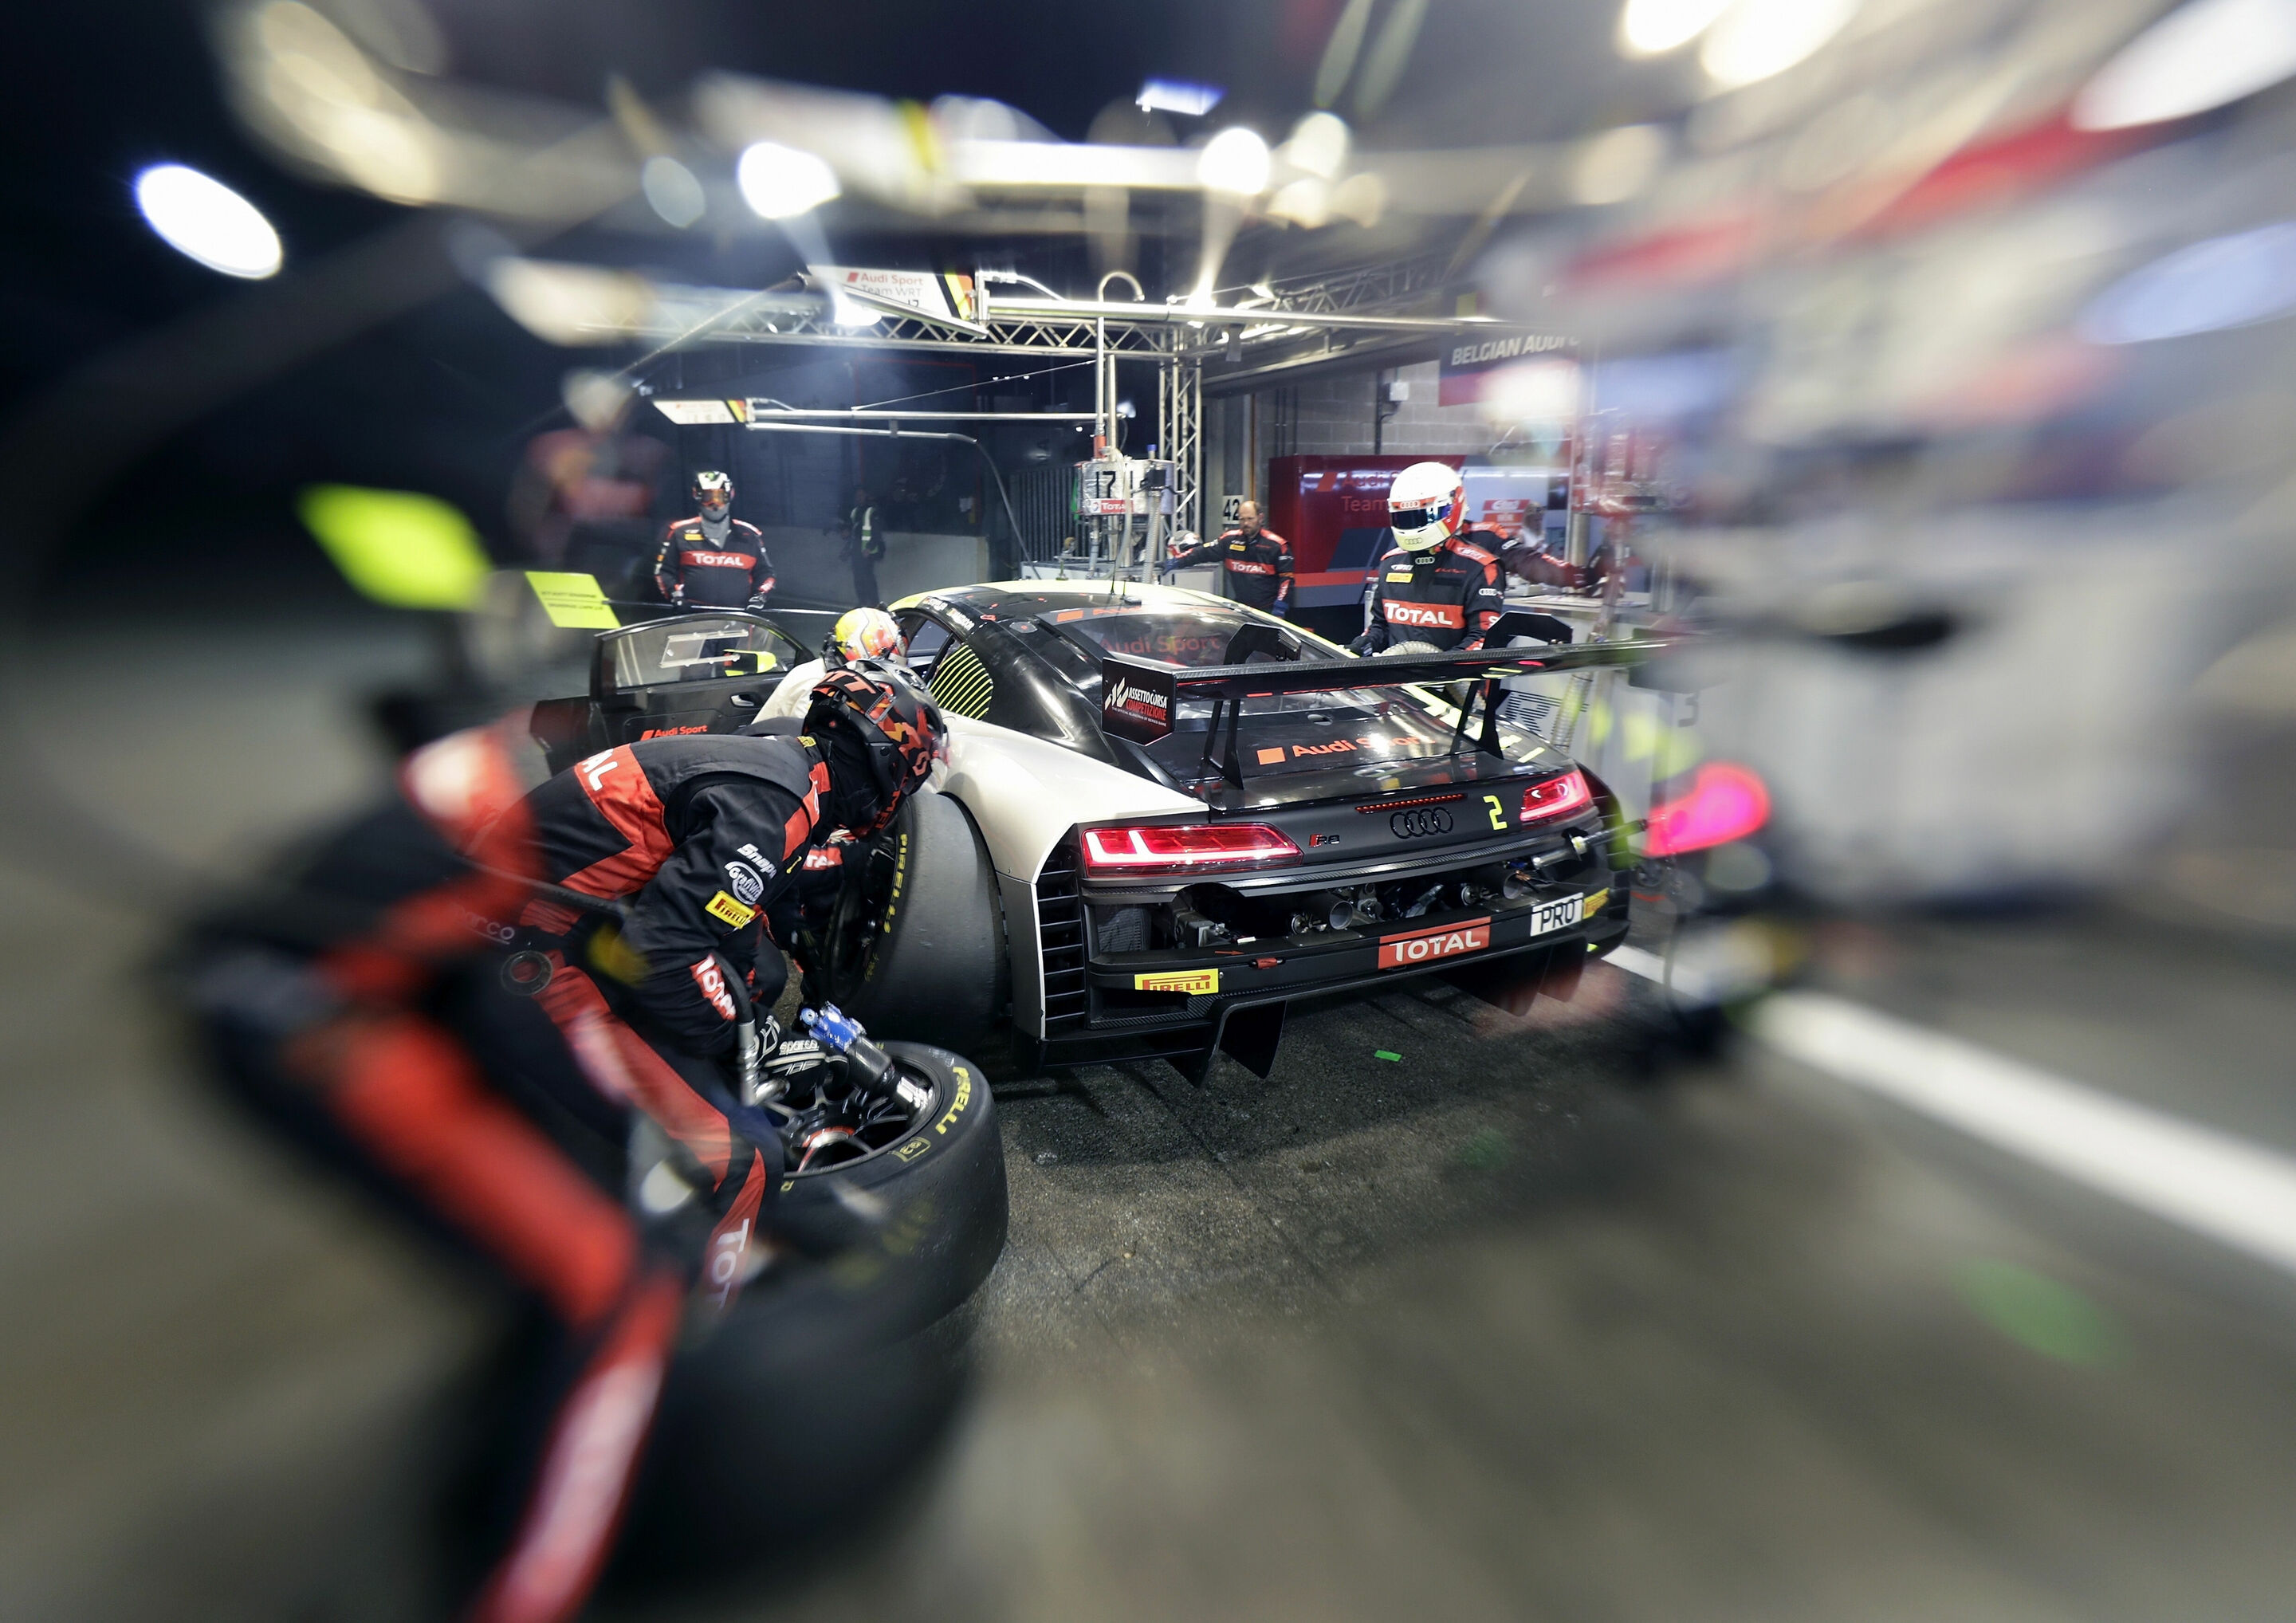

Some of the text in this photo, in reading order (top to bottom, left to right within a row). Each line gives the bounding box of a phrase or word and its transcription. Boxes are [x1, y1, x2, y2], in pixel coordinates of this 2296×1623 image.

[860, 272, 924, 287] Audi Sport
[896, 287, 923, 297] WRT
[1450, 338, 1521, 367] BELGIAN
[1095, 470, 1116, 499] 17
[1341, 470, 1387, 488] Audi
[1223, 498, 1240, 521] 42
[1341, 499, 1390, 512] Team
[692, 552, 744, 567] TOTAL
[1231, 561, 1267, 574] TOTAL
[1384, 603, 1453, 626] TOTAL
[1100, 635, 1222, 655] Audi Sport
[1128, 687, 1168, 709] ASSETTO CORSA
[1126, 698, 1167, 721] COMPETIZIONE
[655, 724, 708, 738] Audi Sport
[1292, 740, 1357, 757] Audi
[1483, 795, 1508, 831] 2
[1539, 899, 1576, 932] PRO
[1389, 931, 1481, 963] TOTAL
[1142, 975, 1211, 992] PIRELLI
